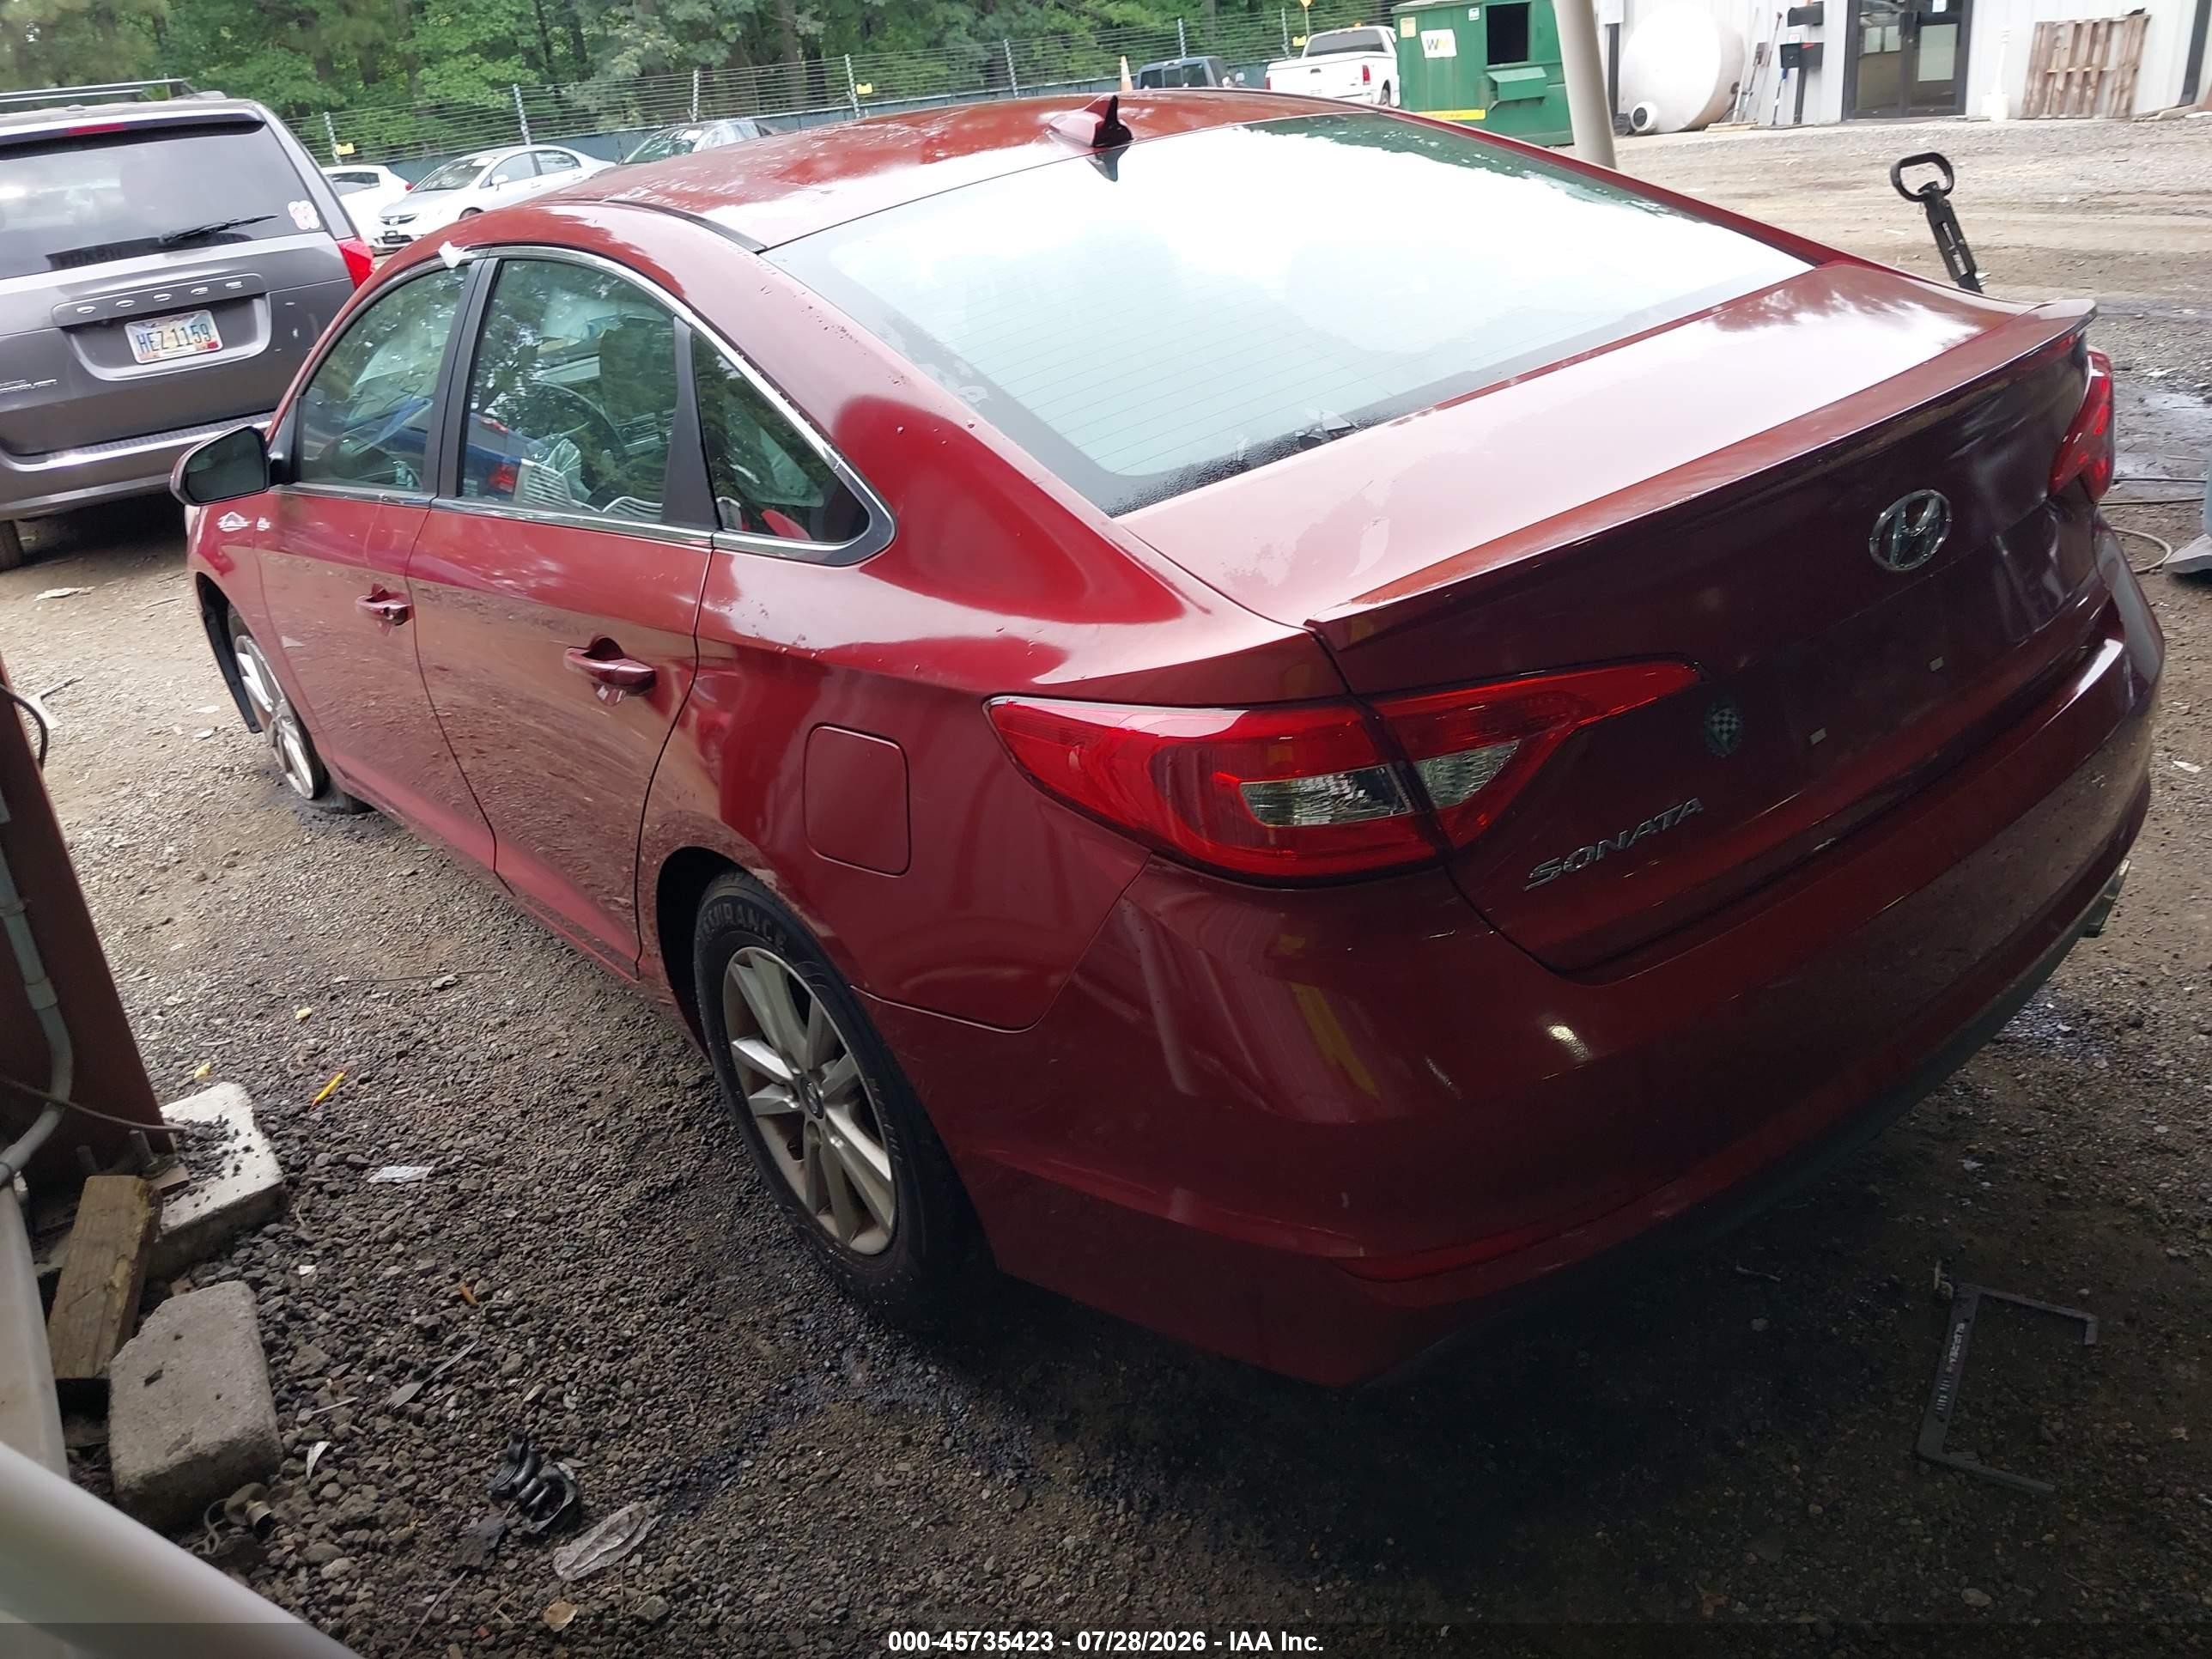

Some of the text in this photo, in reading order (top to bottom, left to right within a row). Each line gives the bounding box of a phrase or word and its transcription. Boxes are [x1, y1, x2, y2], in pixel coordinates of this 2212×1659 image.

[136, 324, 211, 354] HEZ 1159
[1523, 798, 1704, 891] SONATA
